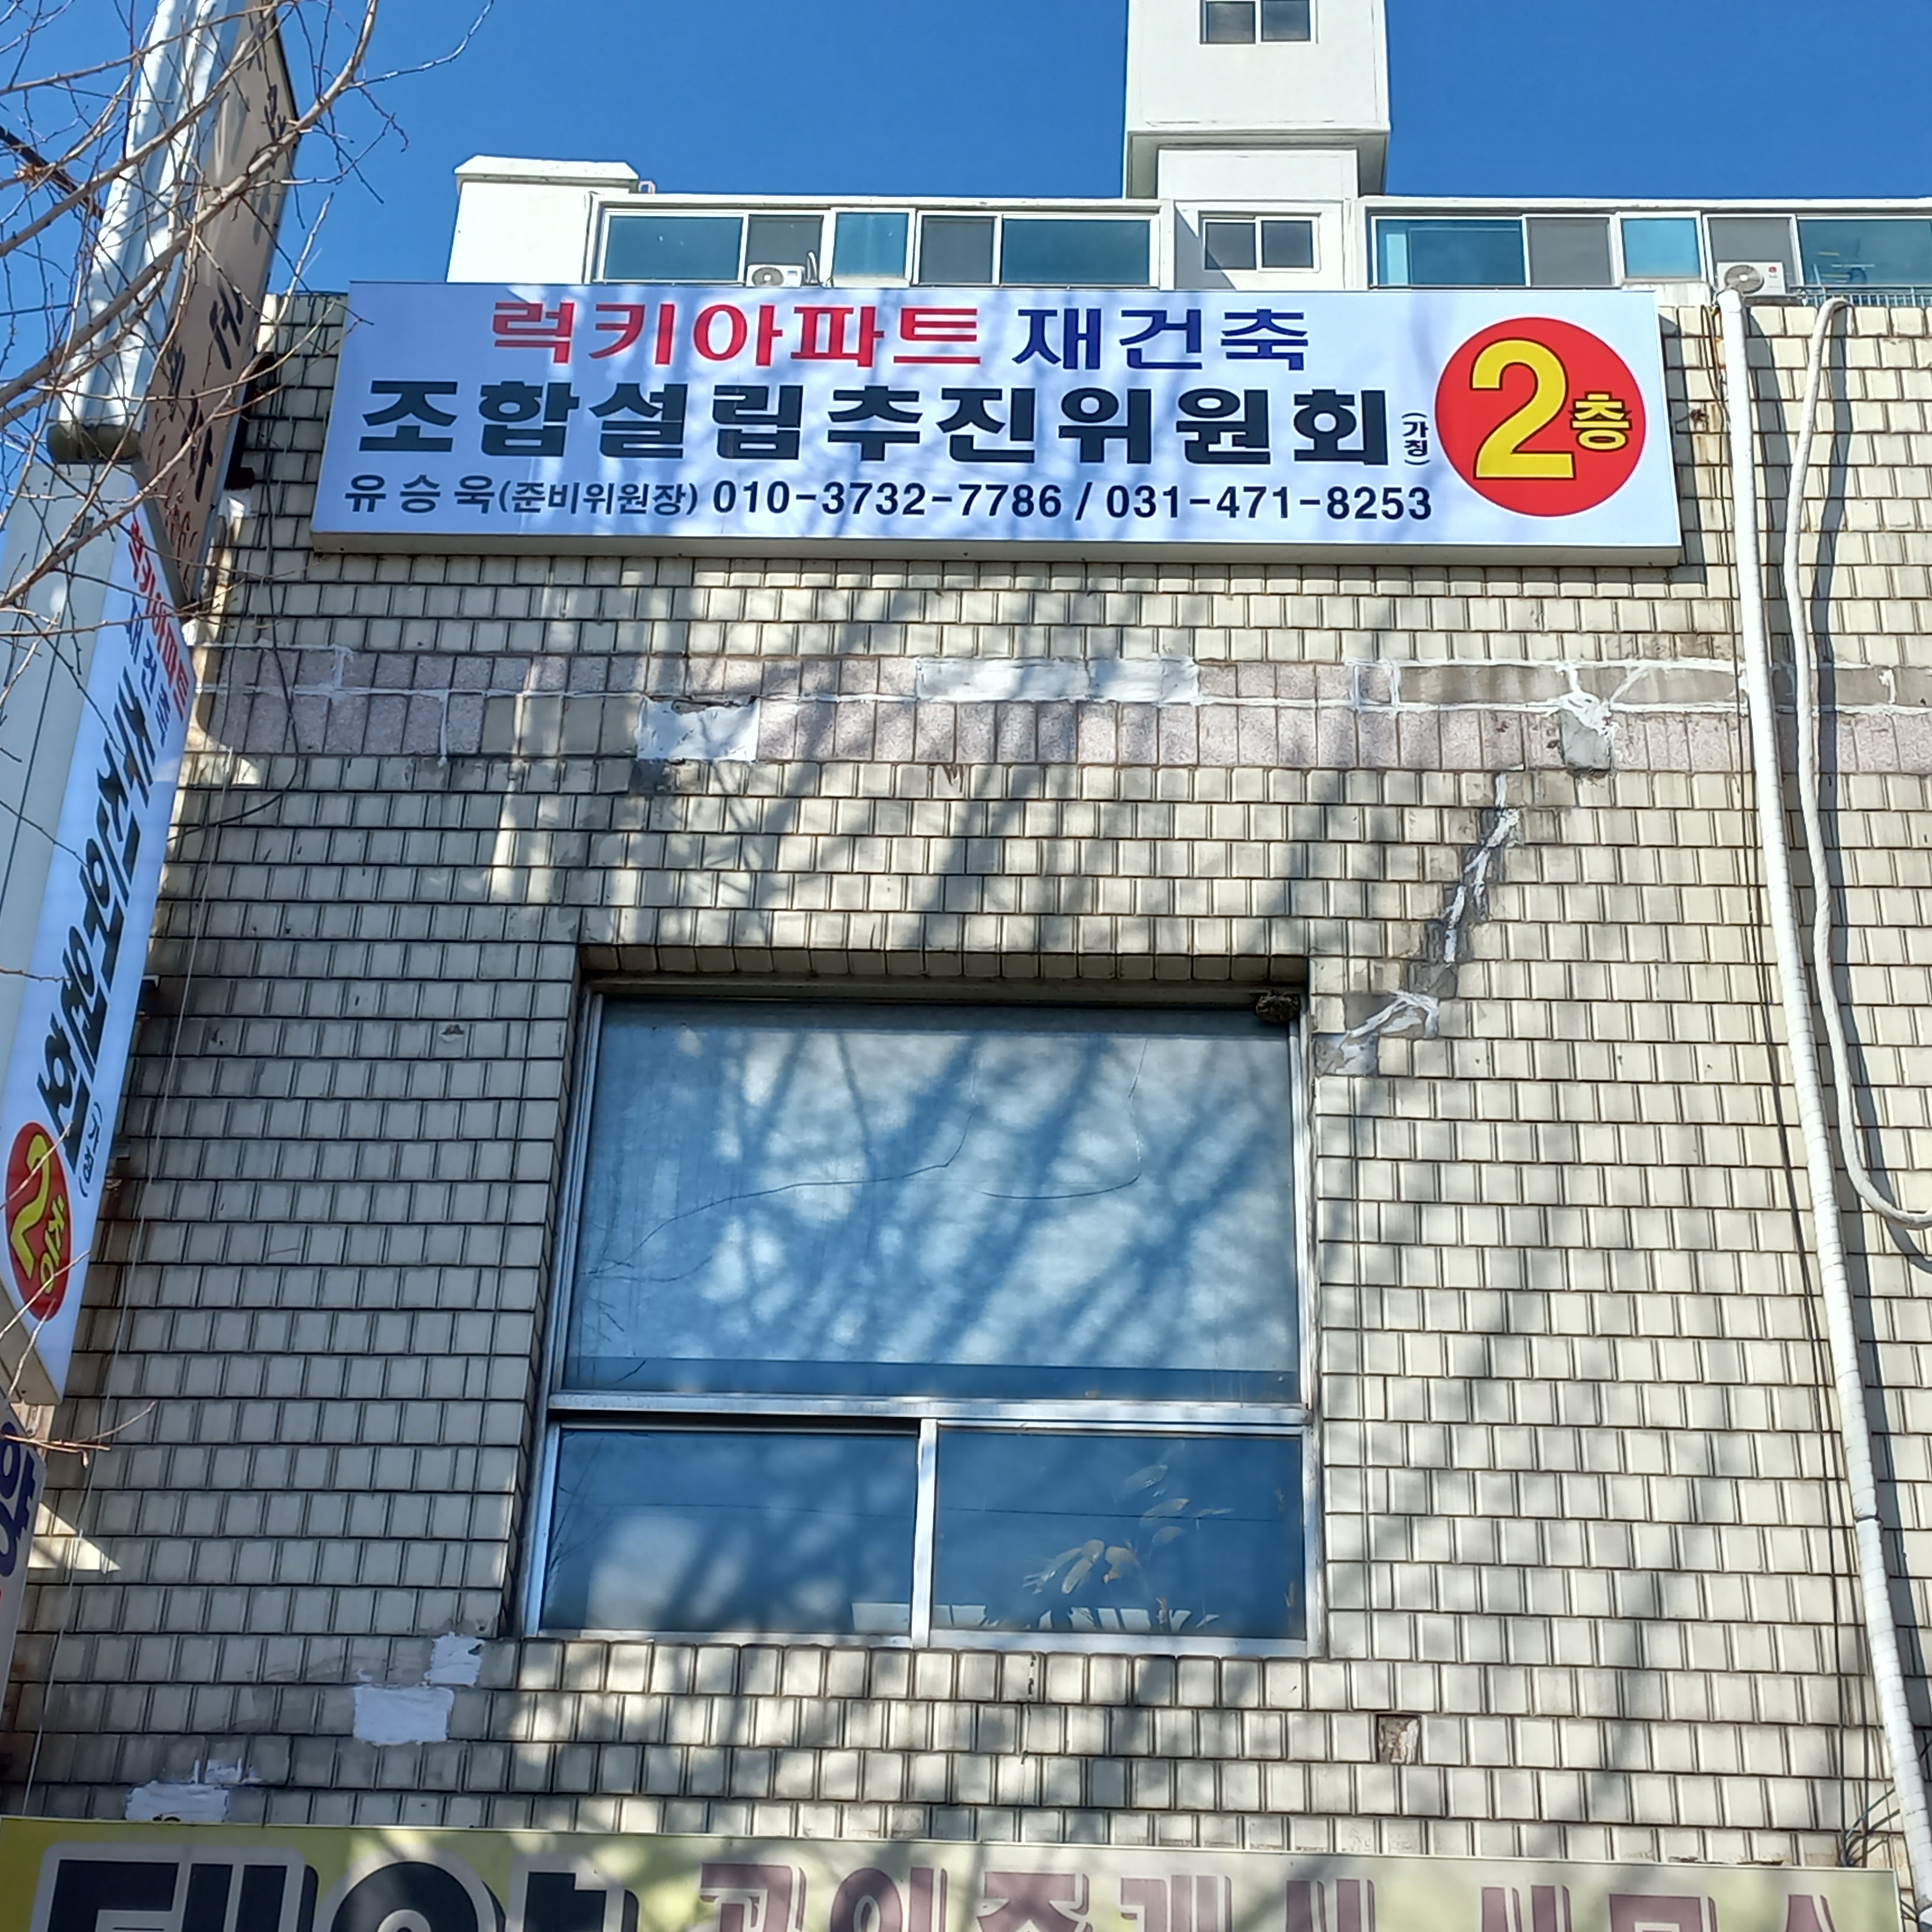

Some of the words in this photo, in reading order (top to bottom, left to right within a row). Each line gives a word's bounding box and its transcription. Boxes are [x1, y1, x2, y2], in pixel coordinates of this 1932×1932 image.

[491, 301, 981, 368] 럭키아파트
[1011, 307, 1309, 372] 재건축
[358, 380, 1390, 466] 조합설립추진위원회
[713, 480, 1062, 520] 010-3732-7786
[1106, 484, 1433, 521] 031-471-8253
[37, 666, 156, 1174] 추진위원회
